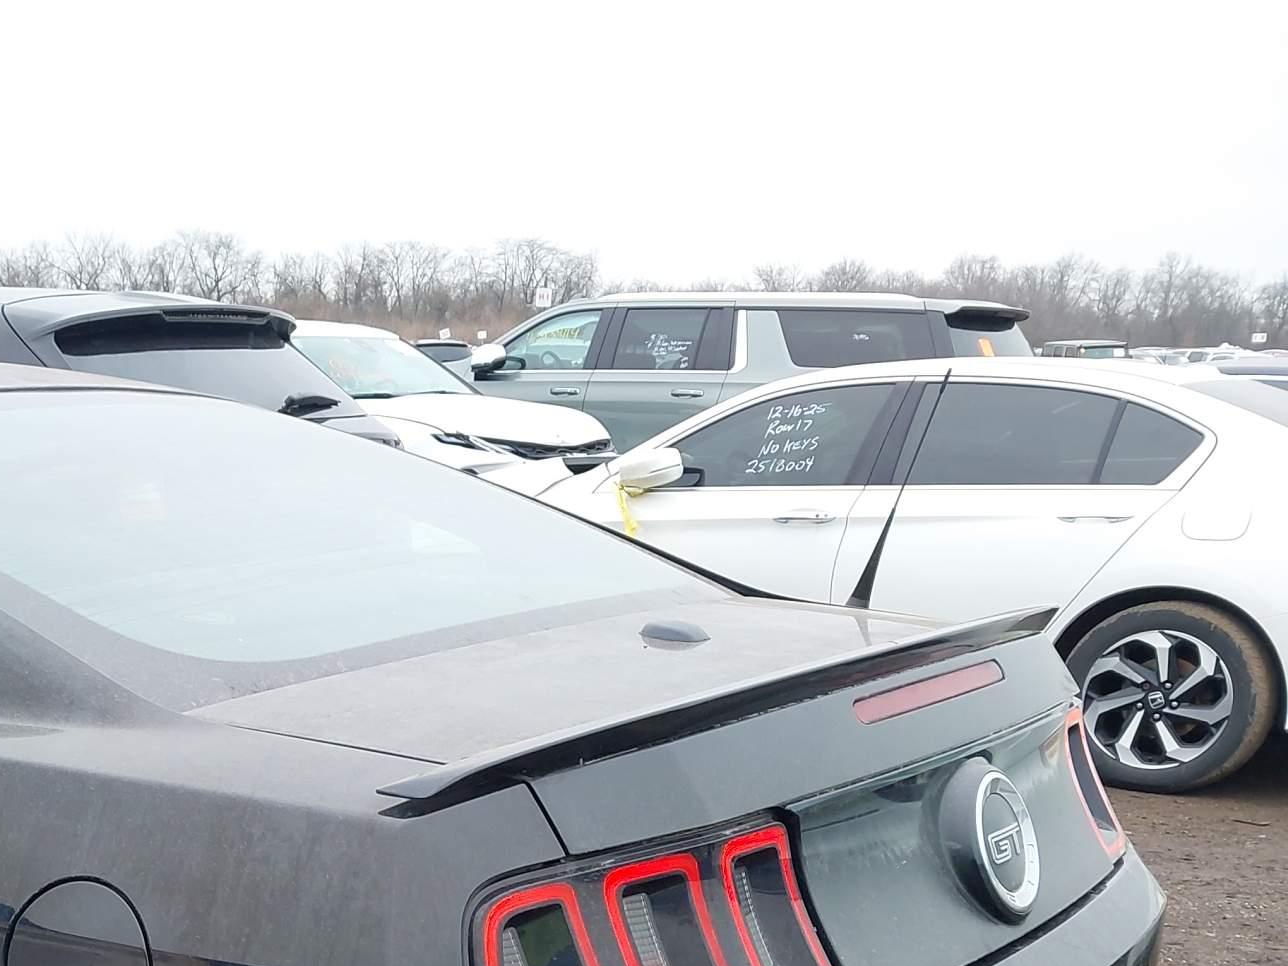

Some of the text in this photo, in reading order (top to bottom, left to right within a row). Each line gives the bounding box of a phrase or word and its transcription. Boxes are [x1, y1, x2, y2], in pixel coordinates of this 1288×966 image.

[767, 403, 832, 421] 12-16-25
[745, 456, 815, 473] 2518004
[987, 822, 1022, 865] GT
